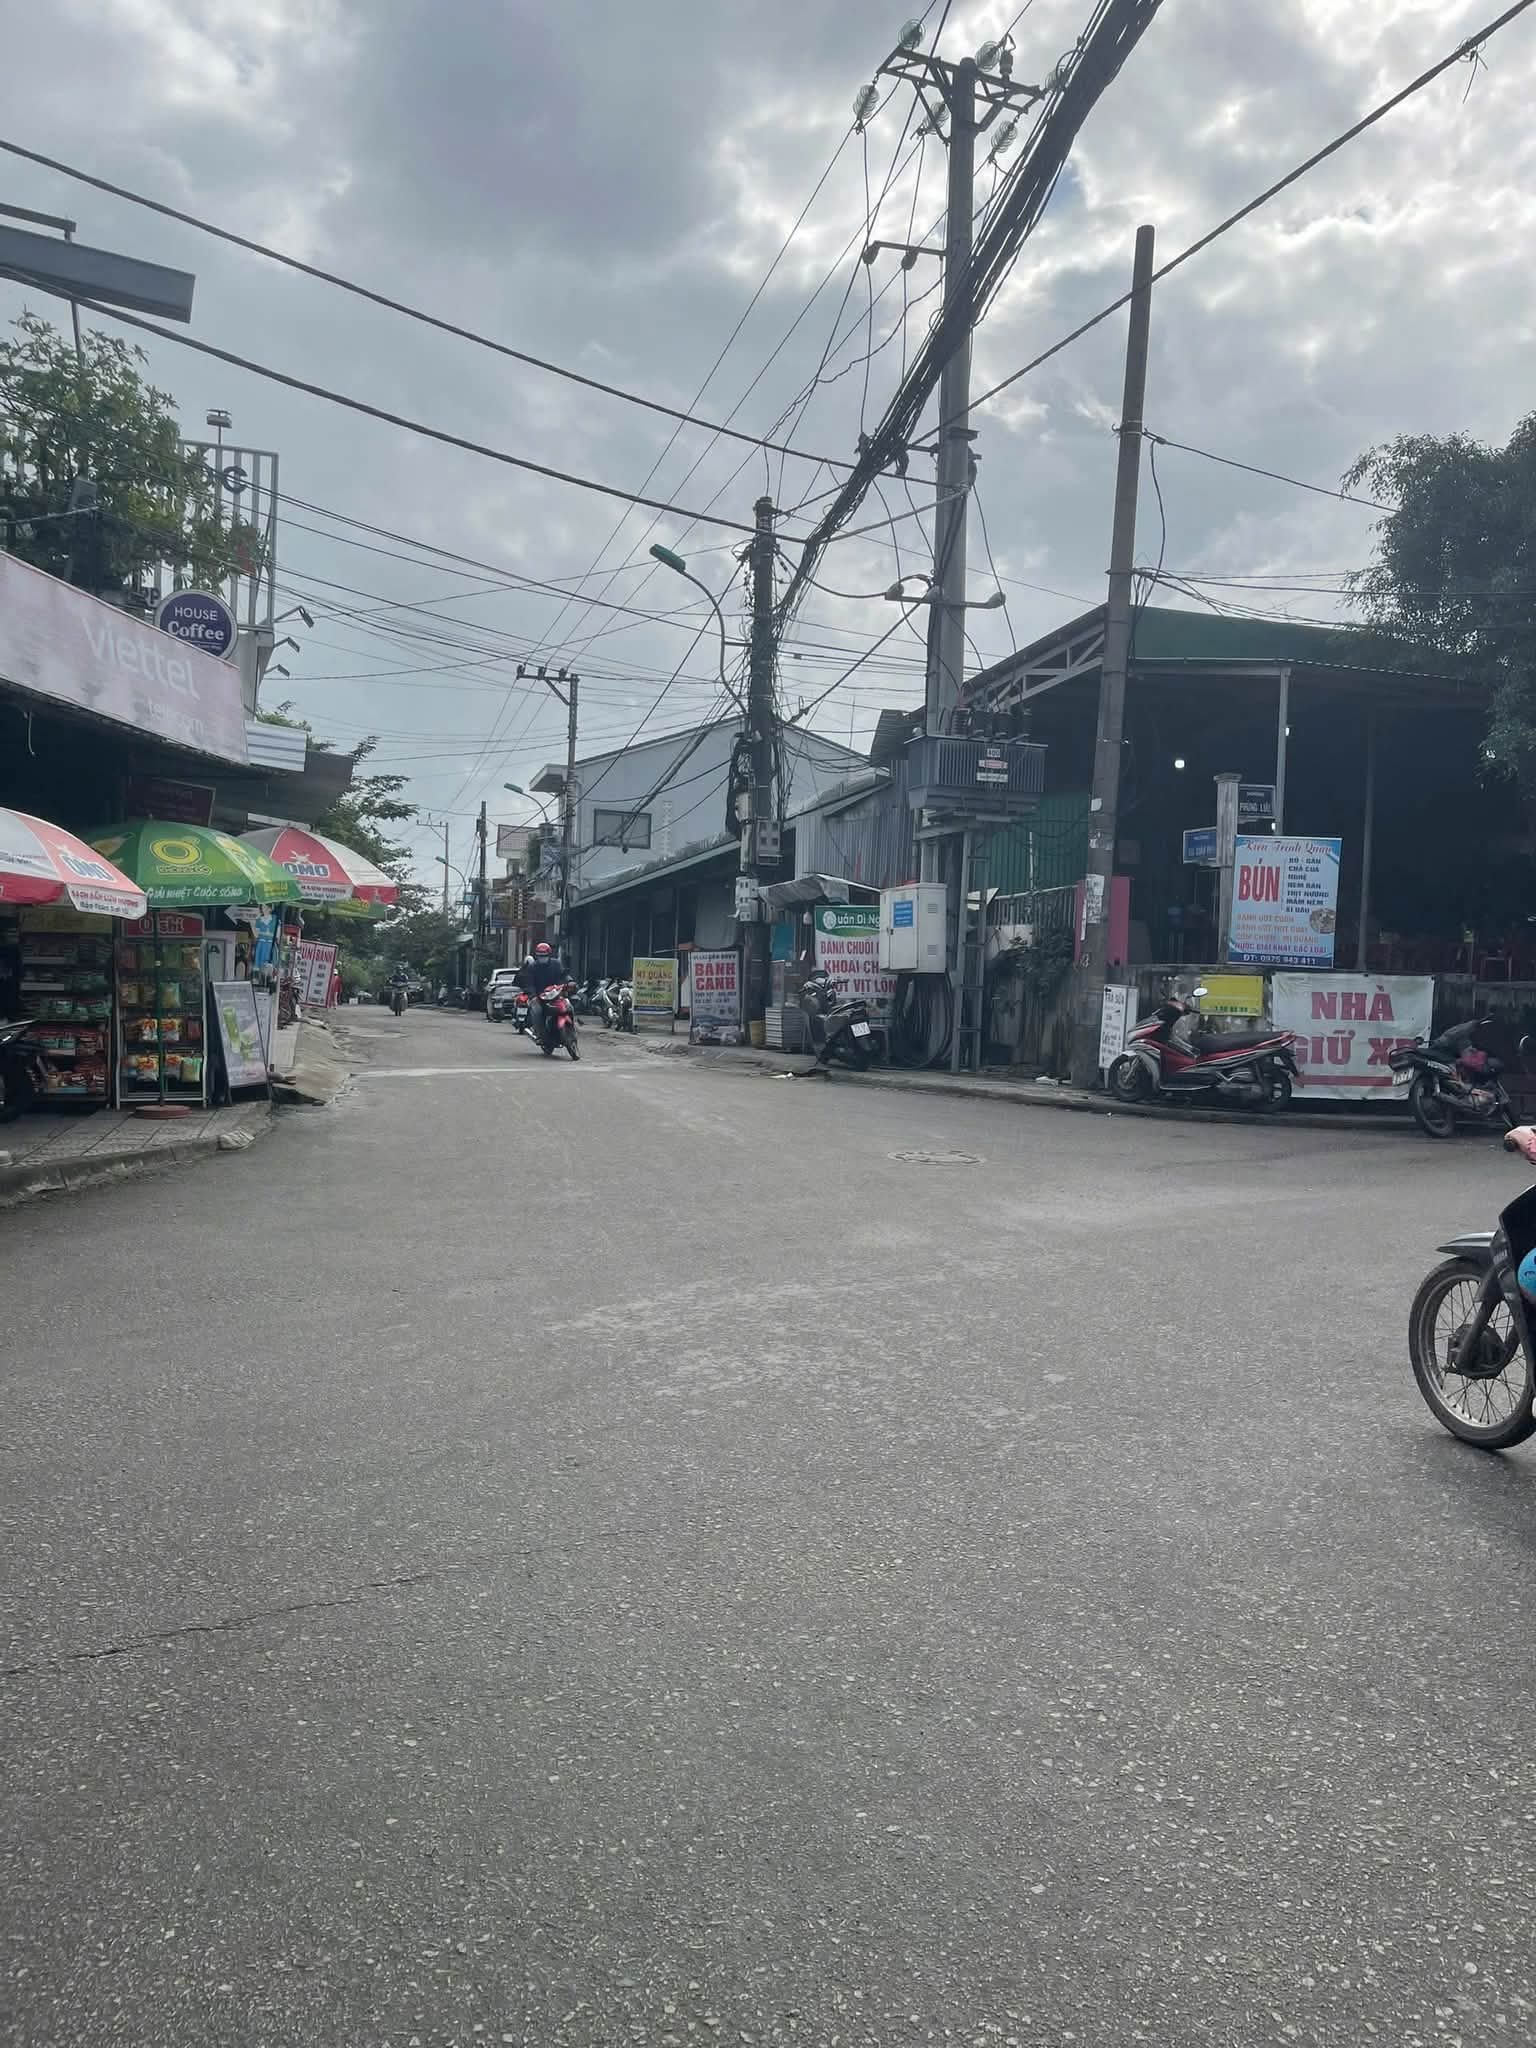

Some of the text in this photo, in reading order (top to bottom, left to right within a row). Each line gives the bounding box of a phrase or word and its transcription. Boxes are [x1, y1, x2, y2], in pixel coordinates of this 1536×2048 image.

[174, 607, 219, 621] HOUSE
[167, 620, 226, 641] Coffee
[284, 862, 330, 877] OMO
[1238, 858, 1281, 903] BÚN
[695, 976, 736, 991] CANH
[1311, 985, 1395, 1022] NHÀ
[1294, 1029, 1357, 1065] GIỮ
